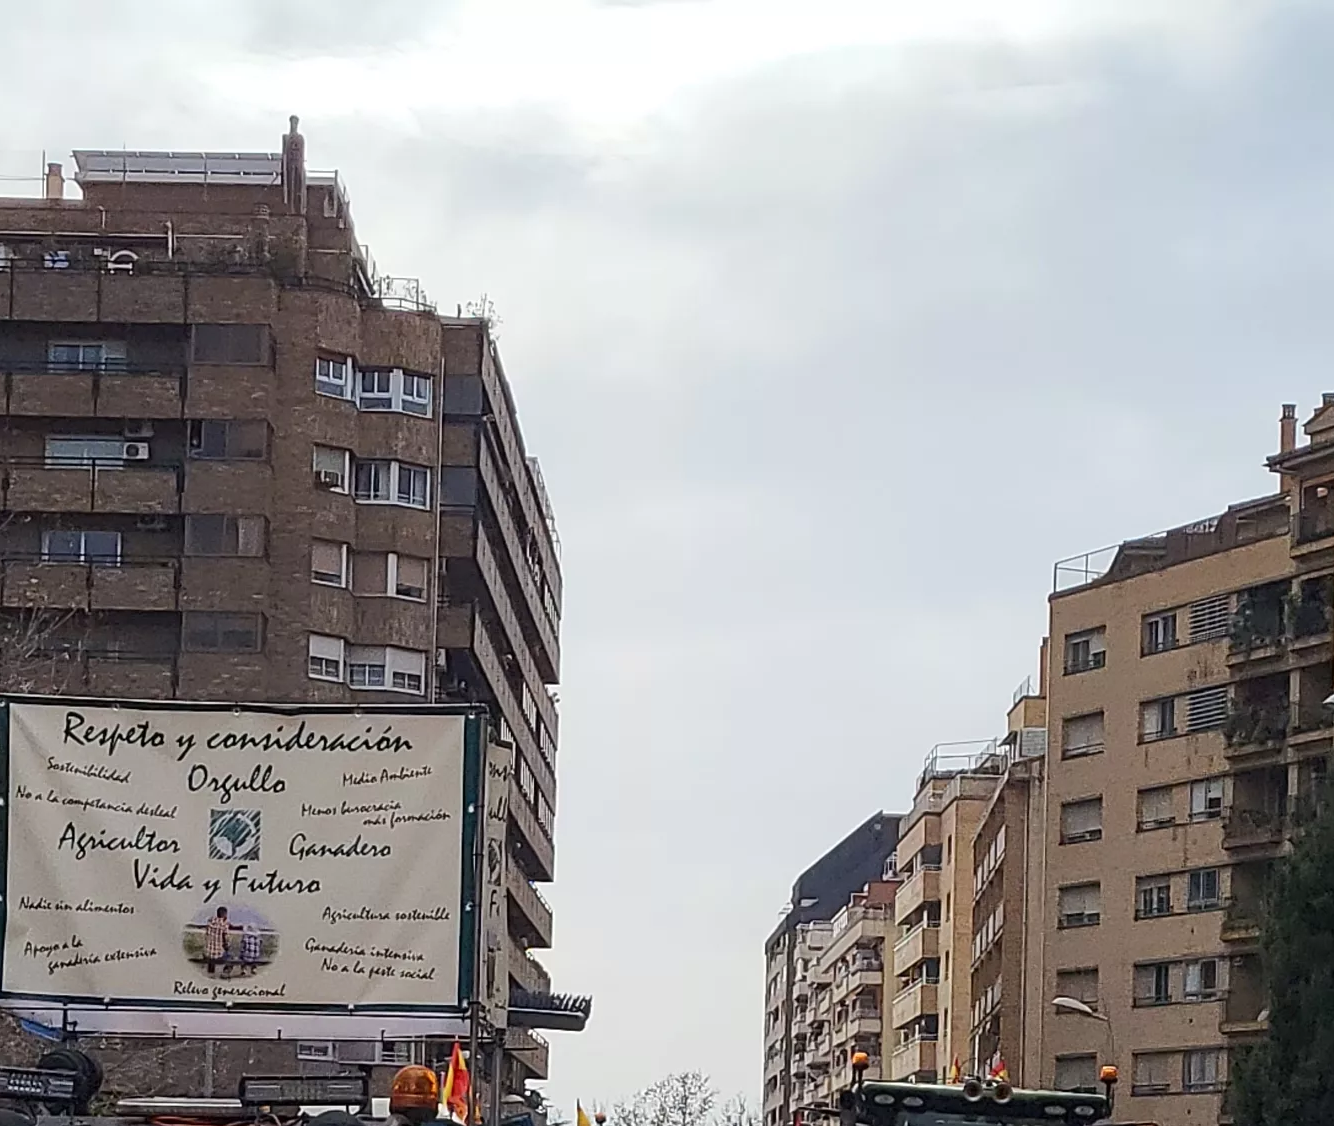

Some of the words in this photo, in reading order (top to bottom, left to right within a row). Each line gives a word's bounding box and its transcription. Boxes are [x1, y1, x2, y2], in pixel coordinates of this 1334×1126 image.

[63, 711, 165, 756] Respeto
[176, 734, 197, 761] y
[206, 721, 413, 752] consideración
[47, 757, 131, 784] Sostenibilidad
[342, 772, 378, 787] Medio
[380, 765, 432, 783] Ambiente
[187, 764, 286, 804] Orgullo
[15, 785, 32, 799] No
[46, 789, 59, 803] la
[136, 802, 178, 819] desleal
[301, 803, 337, 817] Menos
[340, 800, 402, 815] burocracia
[362, 815, 387, 826] más
[389, 808, 451, 829] formación
[58, 822, 181, 860] Agricultor
[289, 833, 392, 860] Ganadero
[133, 858, 194, 891] Vida
[203, 875, 222, 903] y
[231, 864, 322, 896] Futuro
[19, 896, 52, 910] Nadie
[55, 901, 72, 911] sin
[75, 899, 135, 914] alimentos
[322, 906, 390, 924] Agricultura
[395, 907, 450, 921] sostenible
[24, 941, 60, 958] Apoyo
[71, 935, 84, 948] la
[104, 947, 157, 962] extensiva
[369, 947, 425, 962] intensiva
[321, 958, 338, 972] No
[352, 960, 366, 974] la
[399, 967, 435, 980] social
[173, 981, 209, 995] Relevo
[211, 983, 286, 1001] generacional
